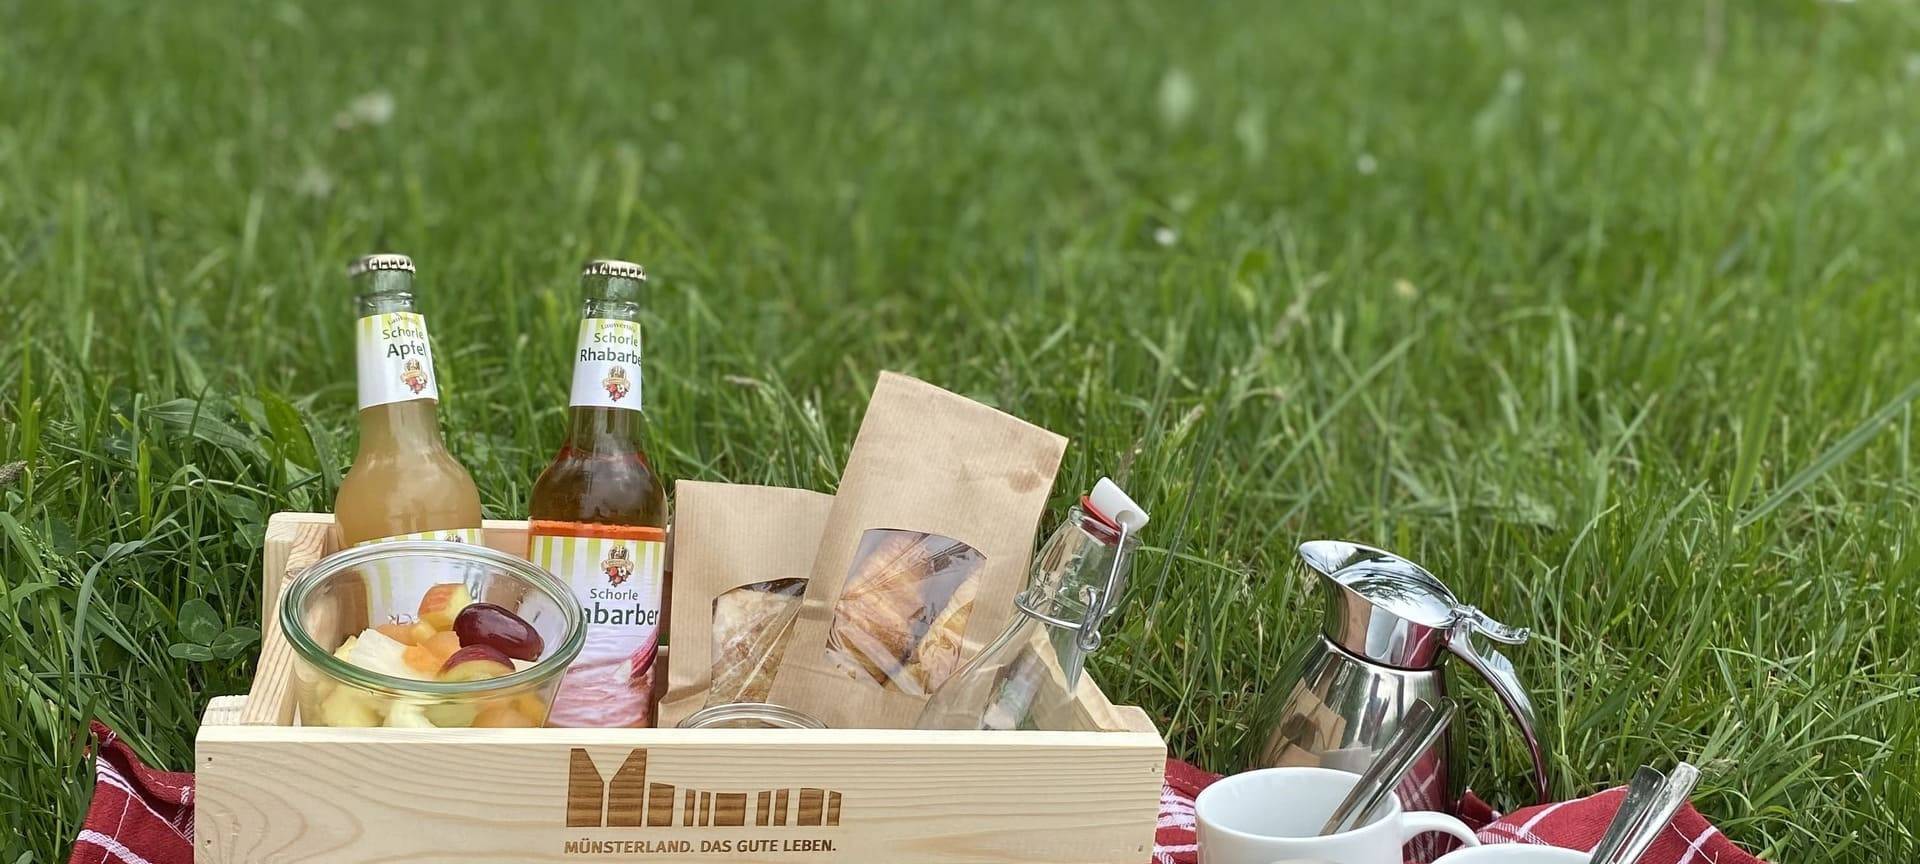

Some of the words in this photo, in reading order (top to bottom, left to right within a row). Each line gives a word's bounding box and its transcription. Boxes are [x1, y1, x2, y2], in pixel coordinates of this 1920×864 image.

[382, 326, 424, 340] Schorle
[594, 332, 638, 347] Schorle
[386, 341, 426, 359] Apfel
[580, 347, 641, 367] Rhabarbe
[590, 588, 639, 601] Schorle
[564, 838, 695, 854] MÜNSTERLAND.
[700, 840, 732, 853] DAS
[736, 839, 779, 853] GUTE
[782, 839, 837, 853] LEBEN.
